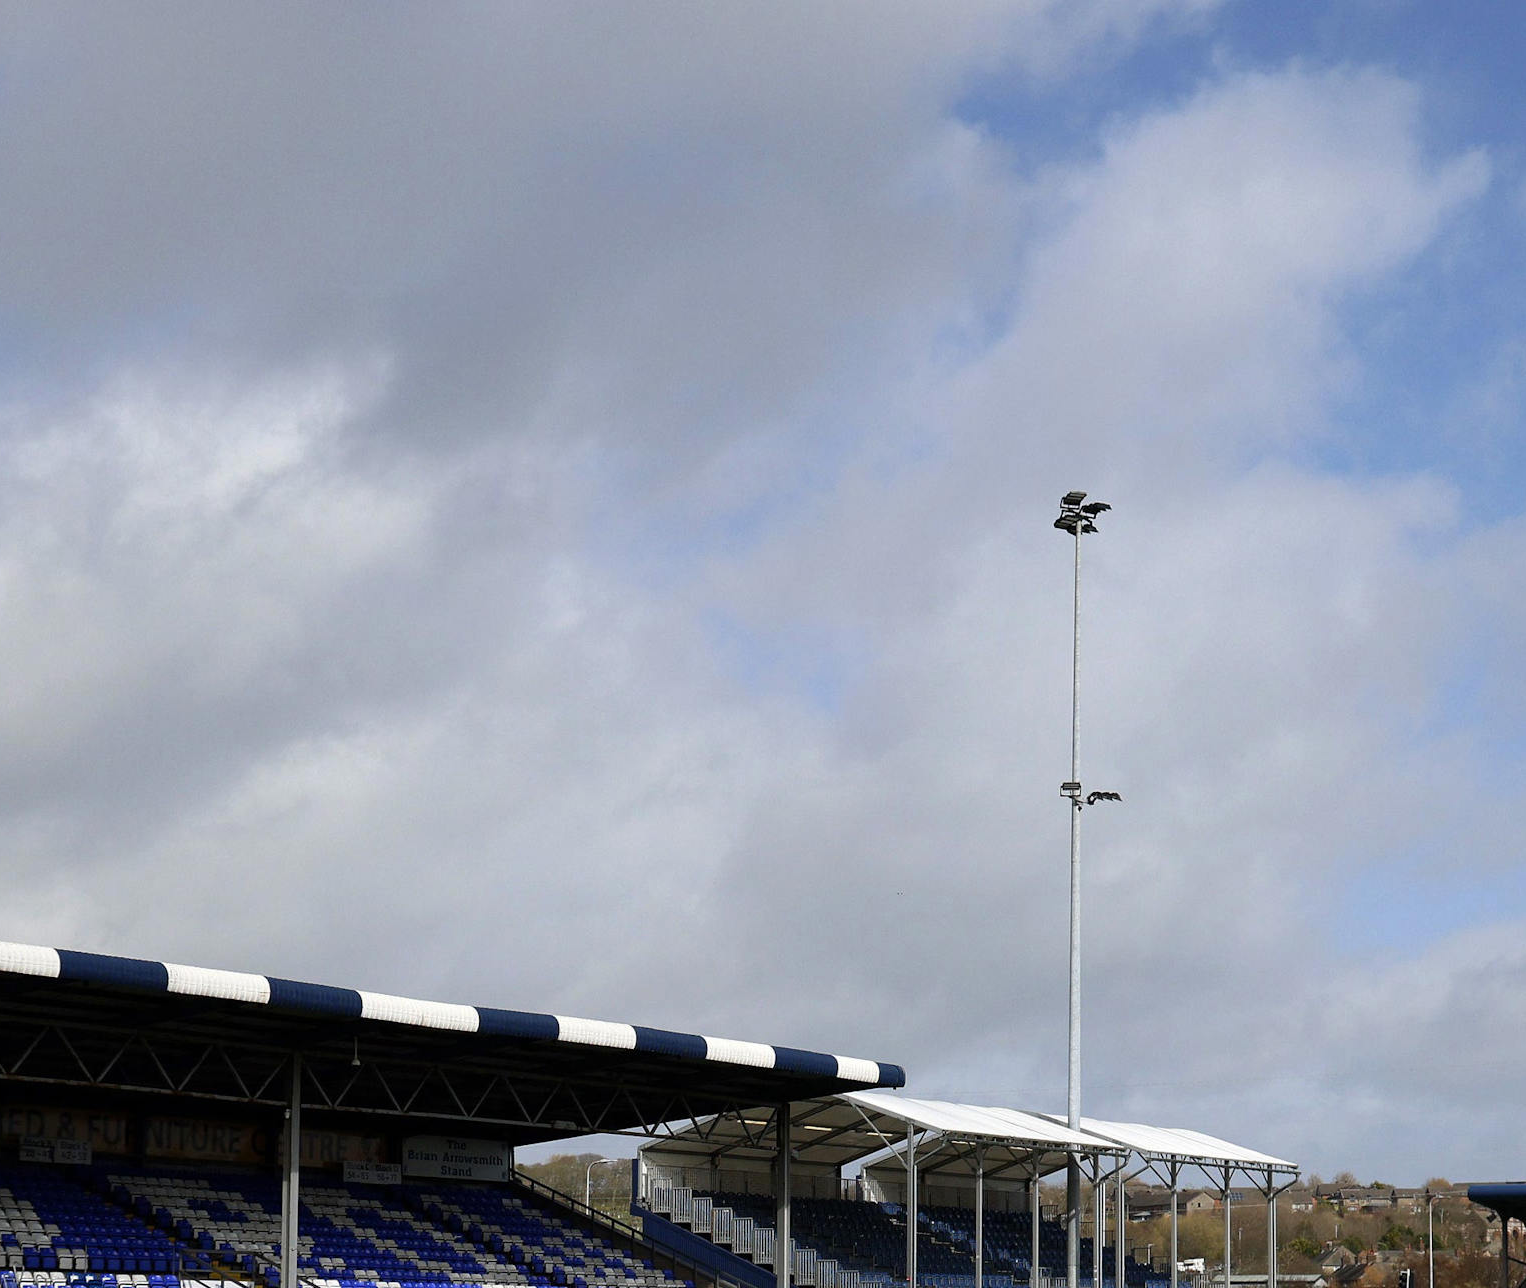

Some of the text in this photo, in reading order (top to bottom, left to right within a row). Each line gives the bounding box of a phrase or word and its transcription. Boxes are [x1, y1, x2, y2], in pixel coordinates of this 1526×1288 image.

[447, 1139, 466, 1150] The
[407, 1150, 503, 1166] Brian Arrowsmith
[440, 1164, 472, 1177] Stand
